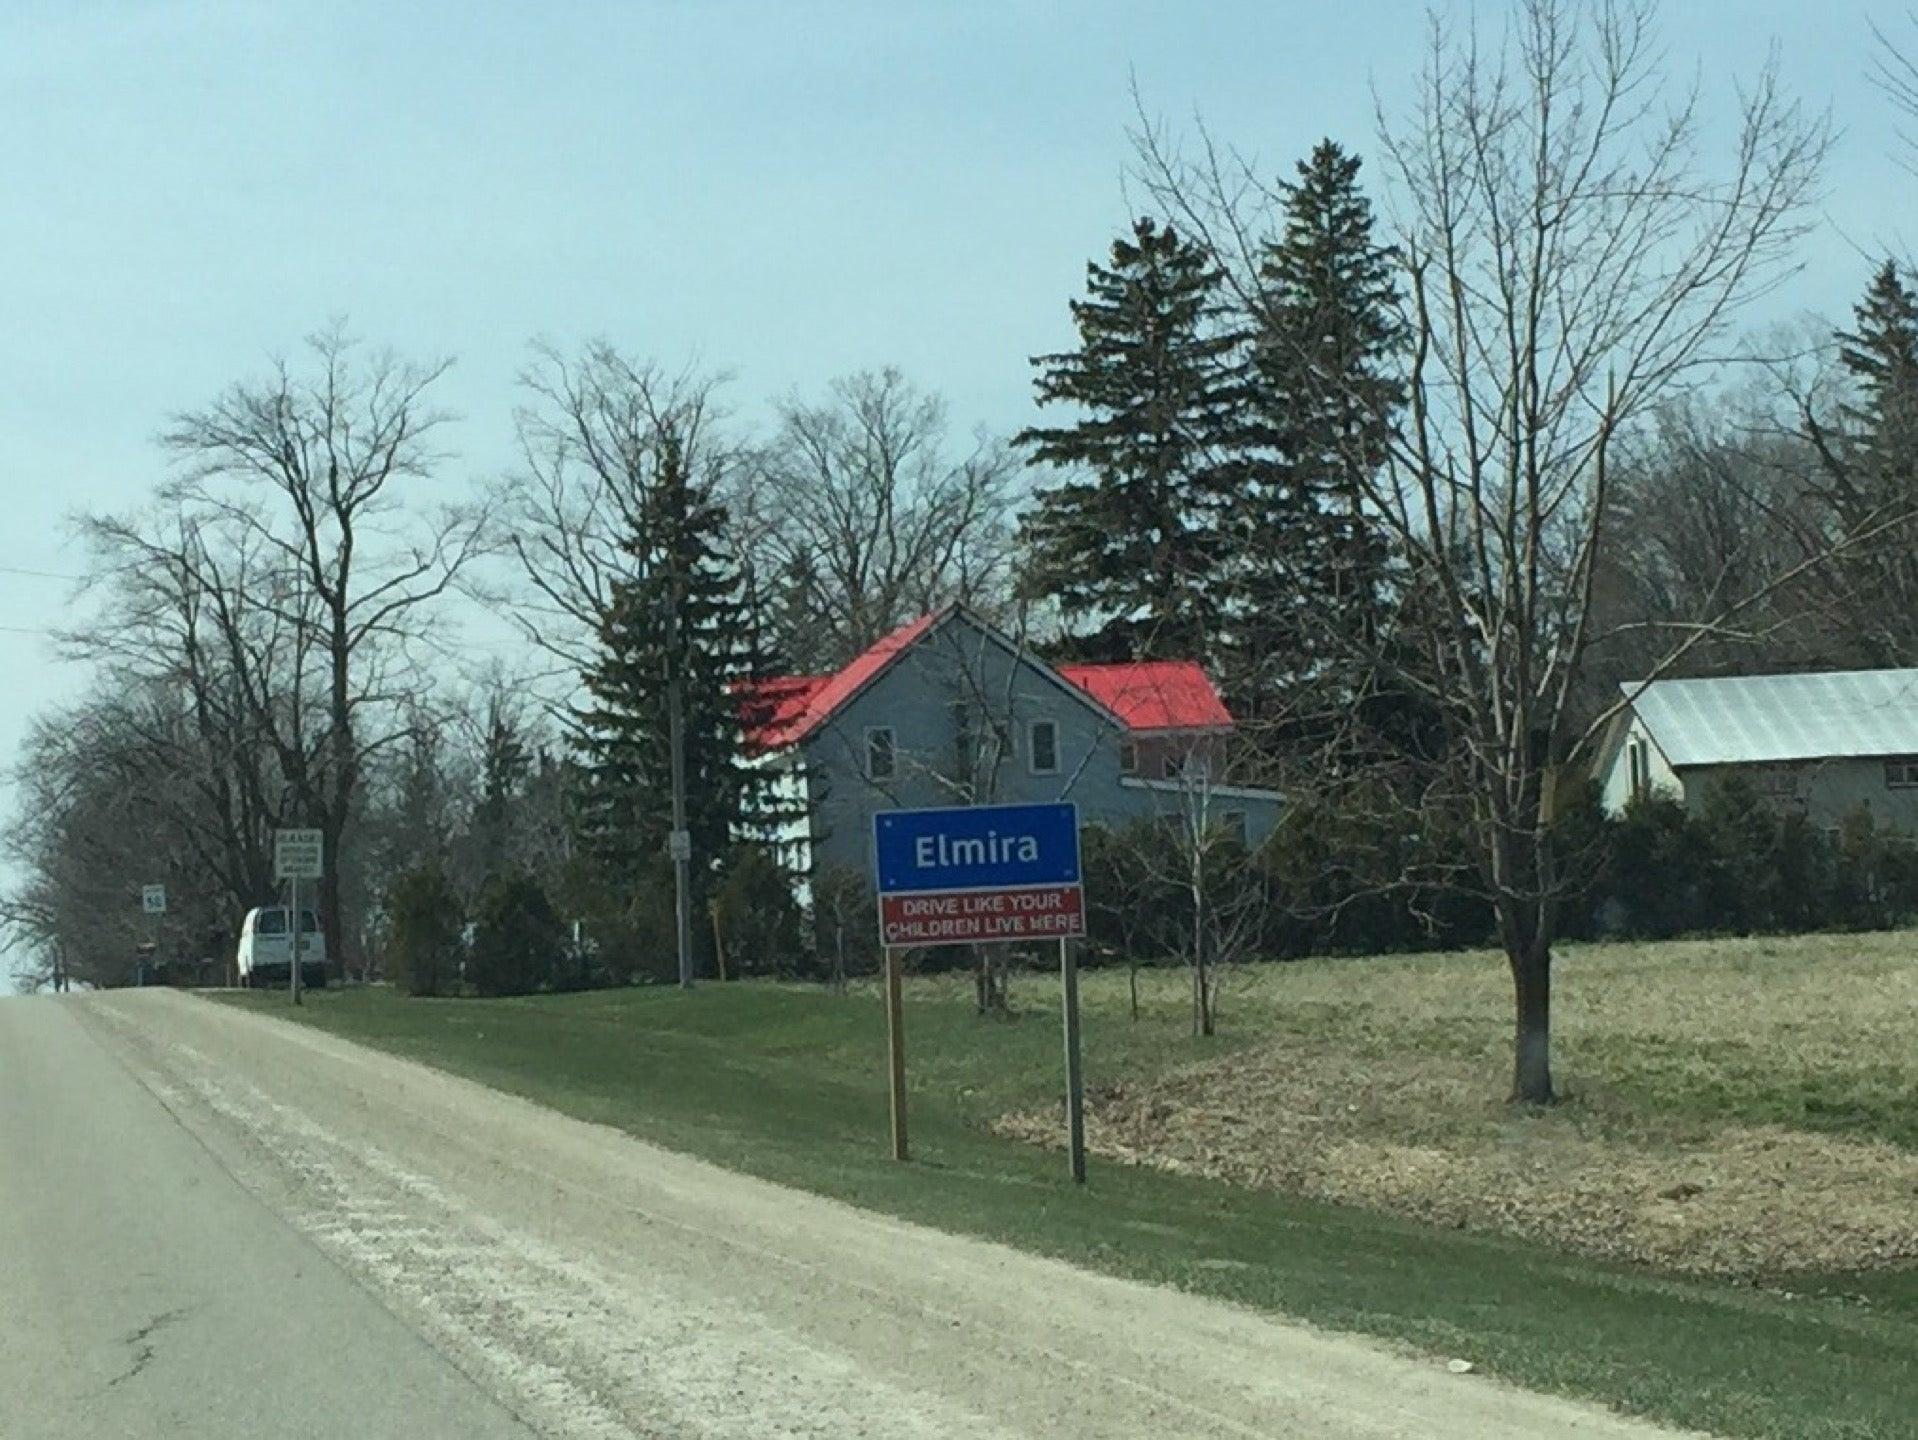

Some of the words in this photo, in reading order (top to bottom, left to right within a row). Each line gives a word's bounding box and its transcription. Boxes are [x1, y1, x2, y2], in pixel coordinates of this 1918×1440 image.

[916, 830, 1038, 868] Elmira
[902, 897, 959, 916] DRIVE
[964, 895, 1005, 913] LIKE
[1008, 894, 1062, 911] YOUR
[886, 917, 980, 937] CHILDREN
[985, 916, 1025, 934] LIVE
[1030, 914, 1080, 930] HERE
